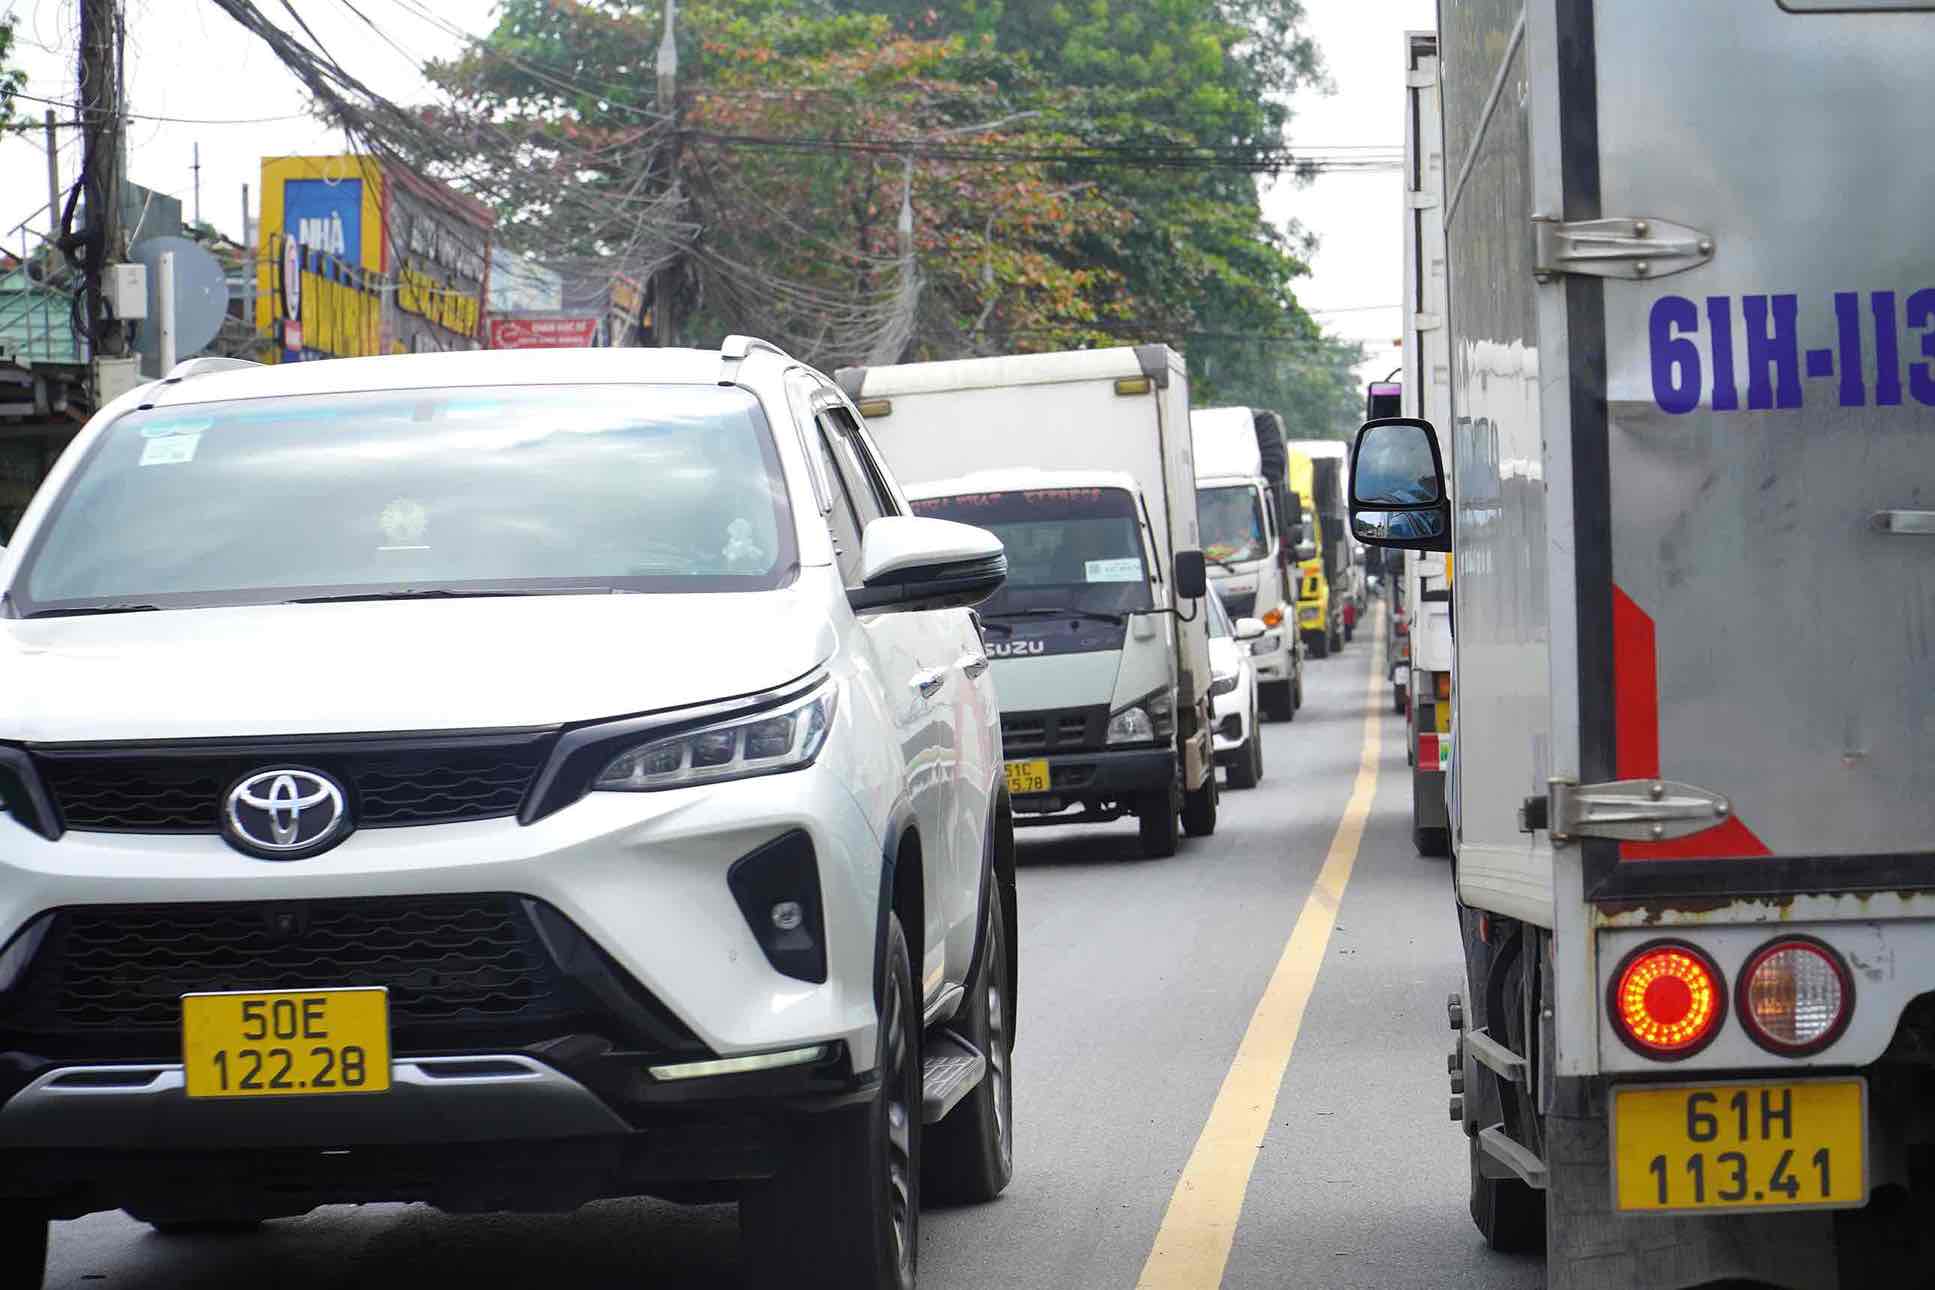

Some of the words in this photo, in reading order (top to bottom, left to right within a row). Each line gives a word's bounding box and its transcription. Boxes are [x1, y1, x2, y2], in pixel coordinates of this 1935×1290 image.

[300, 211, 345, 255] NHÀ
[985, 641, 1044, 657] SUZU
[242, 998, 328, 1040] 50E
[213, 1046, 366, 1090] 122.28
[1686, 1088, 1792, 1142] 61H
[1649, 1147, 1831, 1204] 113.41
